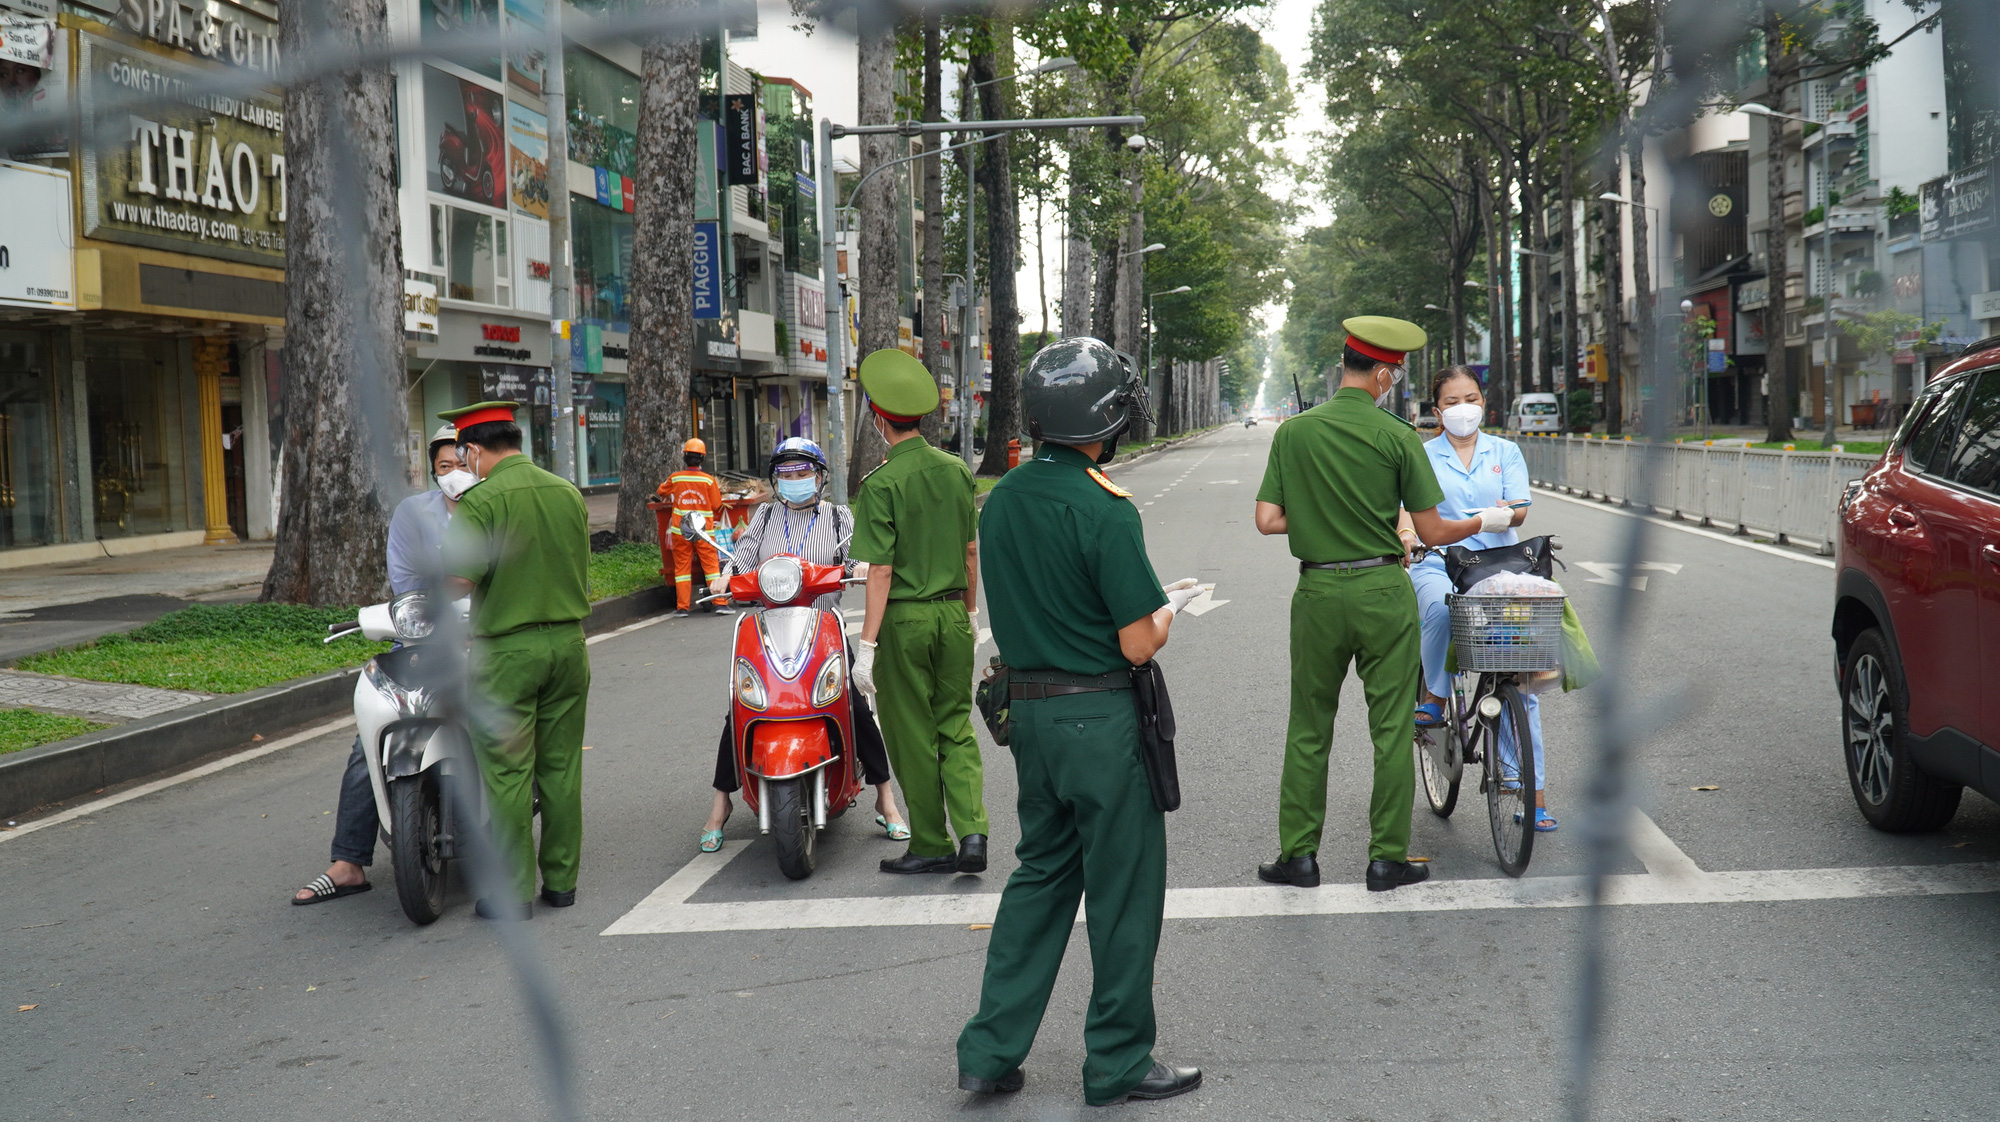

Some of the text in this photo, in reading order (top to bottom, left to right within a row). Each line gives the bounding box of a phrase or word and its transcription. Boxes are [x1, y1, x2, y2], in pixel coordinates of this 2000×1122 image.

[125, 0, 184, 47] SPA
[199, 9, 218, 58] &
[110, 57, 150, 92] CÔNG
[151, 73, 170, 97] TY
[240, 99, 265, 127] LÀM
[129, 115, 259, 215] THẢO
[741, 108, 751, 175] BAC A BANK
[113, 201, 239, 240] www.thaotay.com
[693, 231, 711, 310] PIAGGIO
